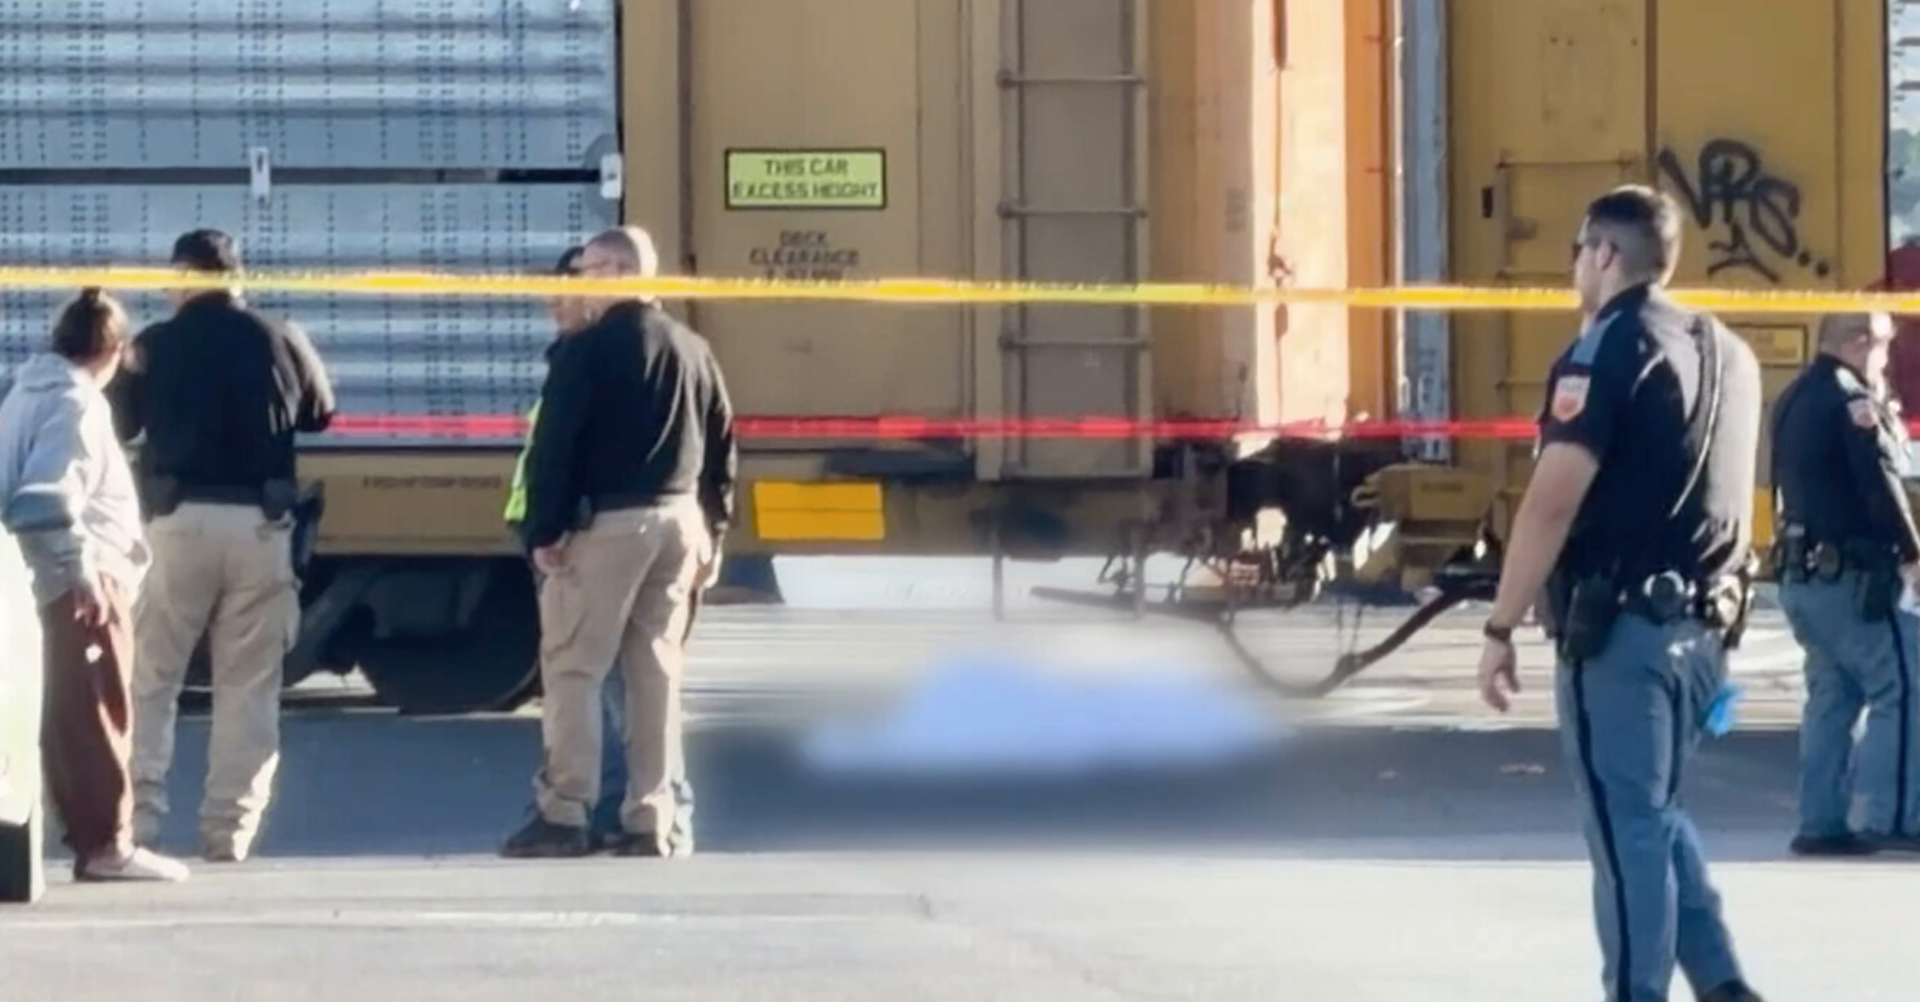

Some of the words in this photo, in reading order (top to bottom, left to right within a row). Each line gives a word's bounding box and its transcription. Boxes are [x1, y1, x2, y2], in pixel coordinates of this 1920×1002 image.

[764, 158, 805, 176] THIS
[809, 158, 849, 176] CAR
[733, 182, 808, 199] EXCESS
[813, 182, 878, 199] HEIGHT
